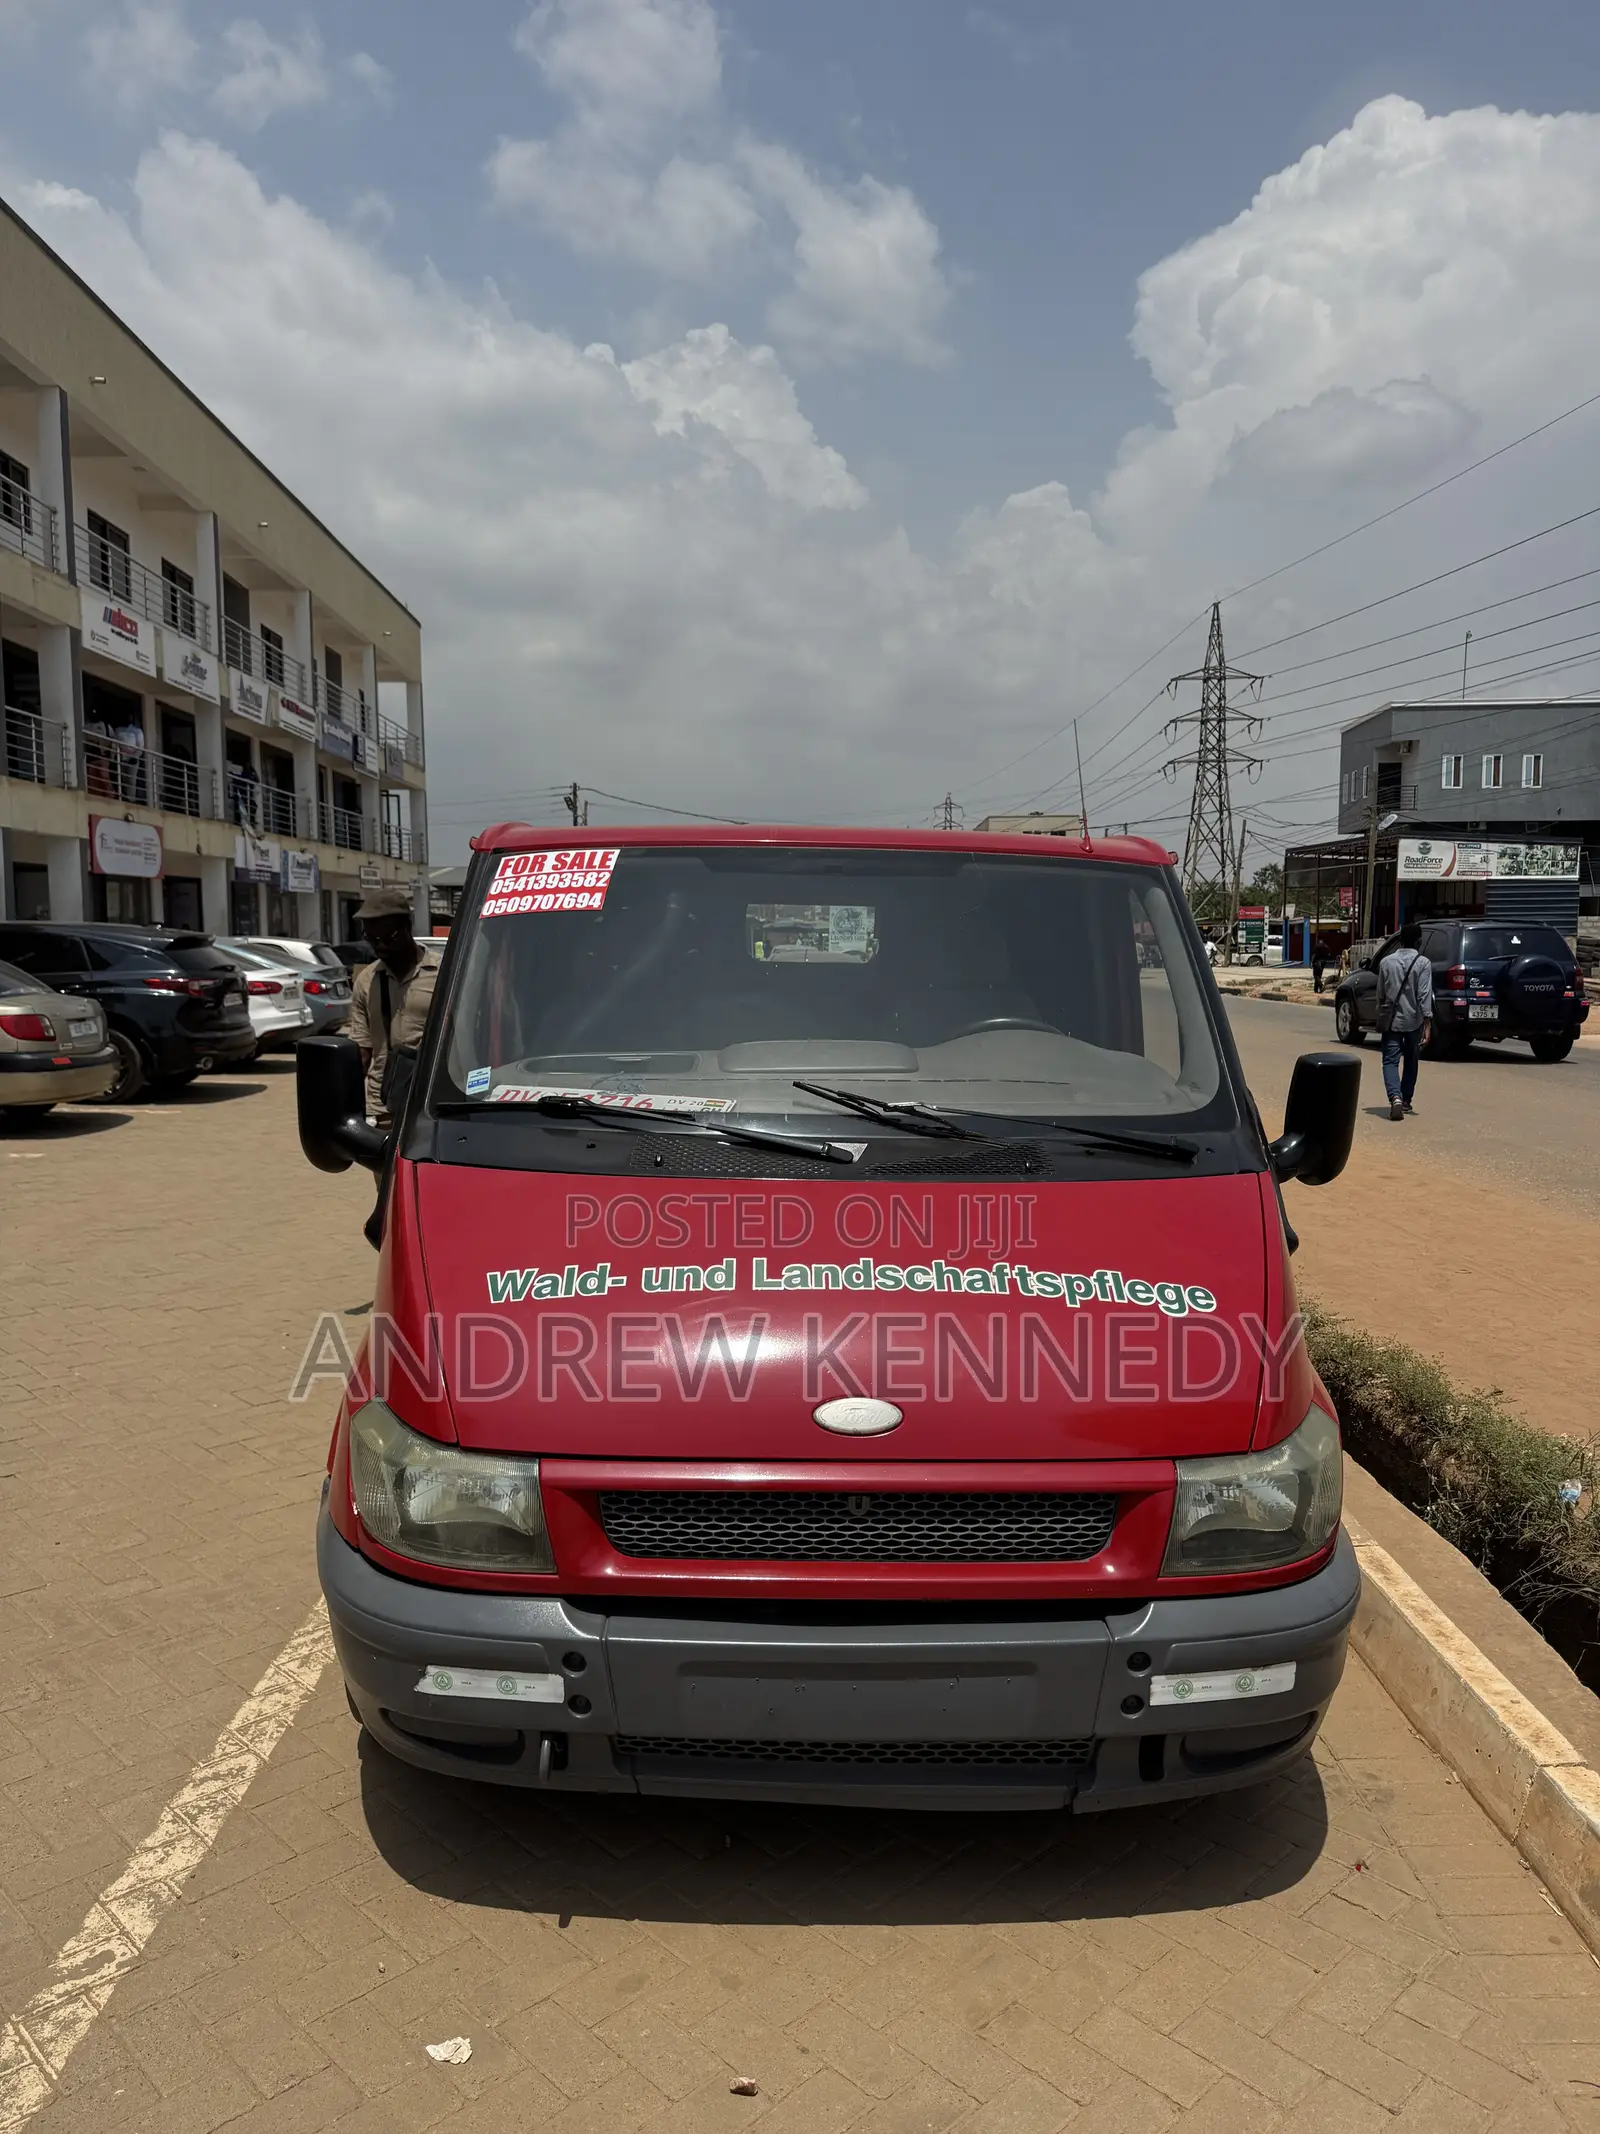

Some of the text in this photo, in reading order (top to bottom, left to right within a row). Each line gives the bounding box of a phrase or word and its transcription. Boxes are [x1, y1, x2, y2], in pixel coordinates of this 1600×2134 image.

[498, 851, 615, 878] FOR SALE
[489, 871, 611, 895] 0541393582
[481, 892, 603, 916] 0509707694
[486, 1257, 1217, 1317] Wald- und Landschaftspflege
